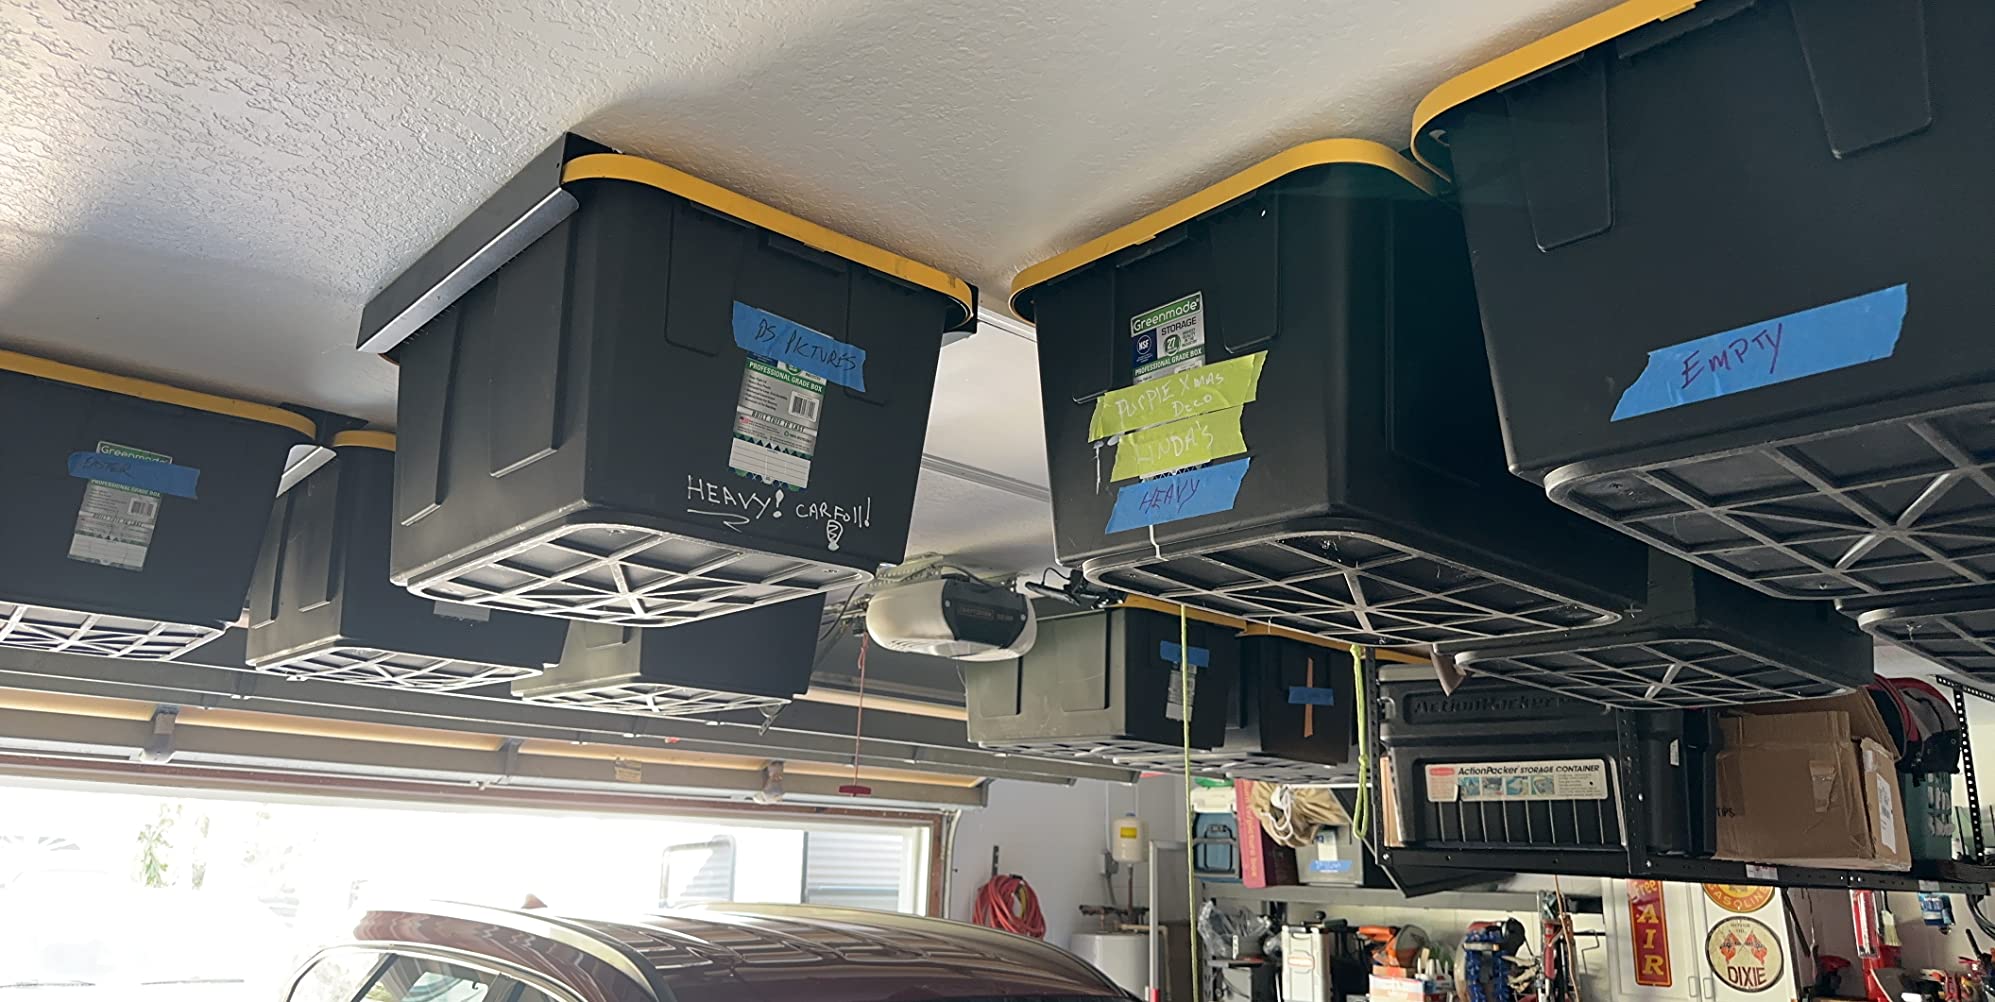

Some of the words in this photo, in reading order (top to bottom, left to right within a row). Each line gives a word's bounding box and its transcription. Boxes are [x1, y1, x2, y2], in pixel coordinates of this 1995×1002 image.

[1133, 301, 1197, 331] Greenmade
[1162, 317, 1197, 336] STORAGE
[1138, 339, 1149, 351] NSF
[1167, 337, 1176, 349] 27
[1134, 359, 1172, 376] PROFESSIONAL
[1172, 352, 1189, 363] GRADE
[1190, 347, 1202, 358] BOX
[749, 361, 790, 382] PROFESSIONAL
[791, 374, 810, 388] GRADE
[811, 382, 823, 393] BOX
[687, 474, 784, 520] HEAVY!
[1139, 478, 1201, 514] HEAVY
[1458, 765, 1517, 775] ActionPacker
[1555, 764, 1600, 773] CONTAINER
[1637, 904, 1664, 976] AIR
[1728, 966, 1767, 987] DIXIE
